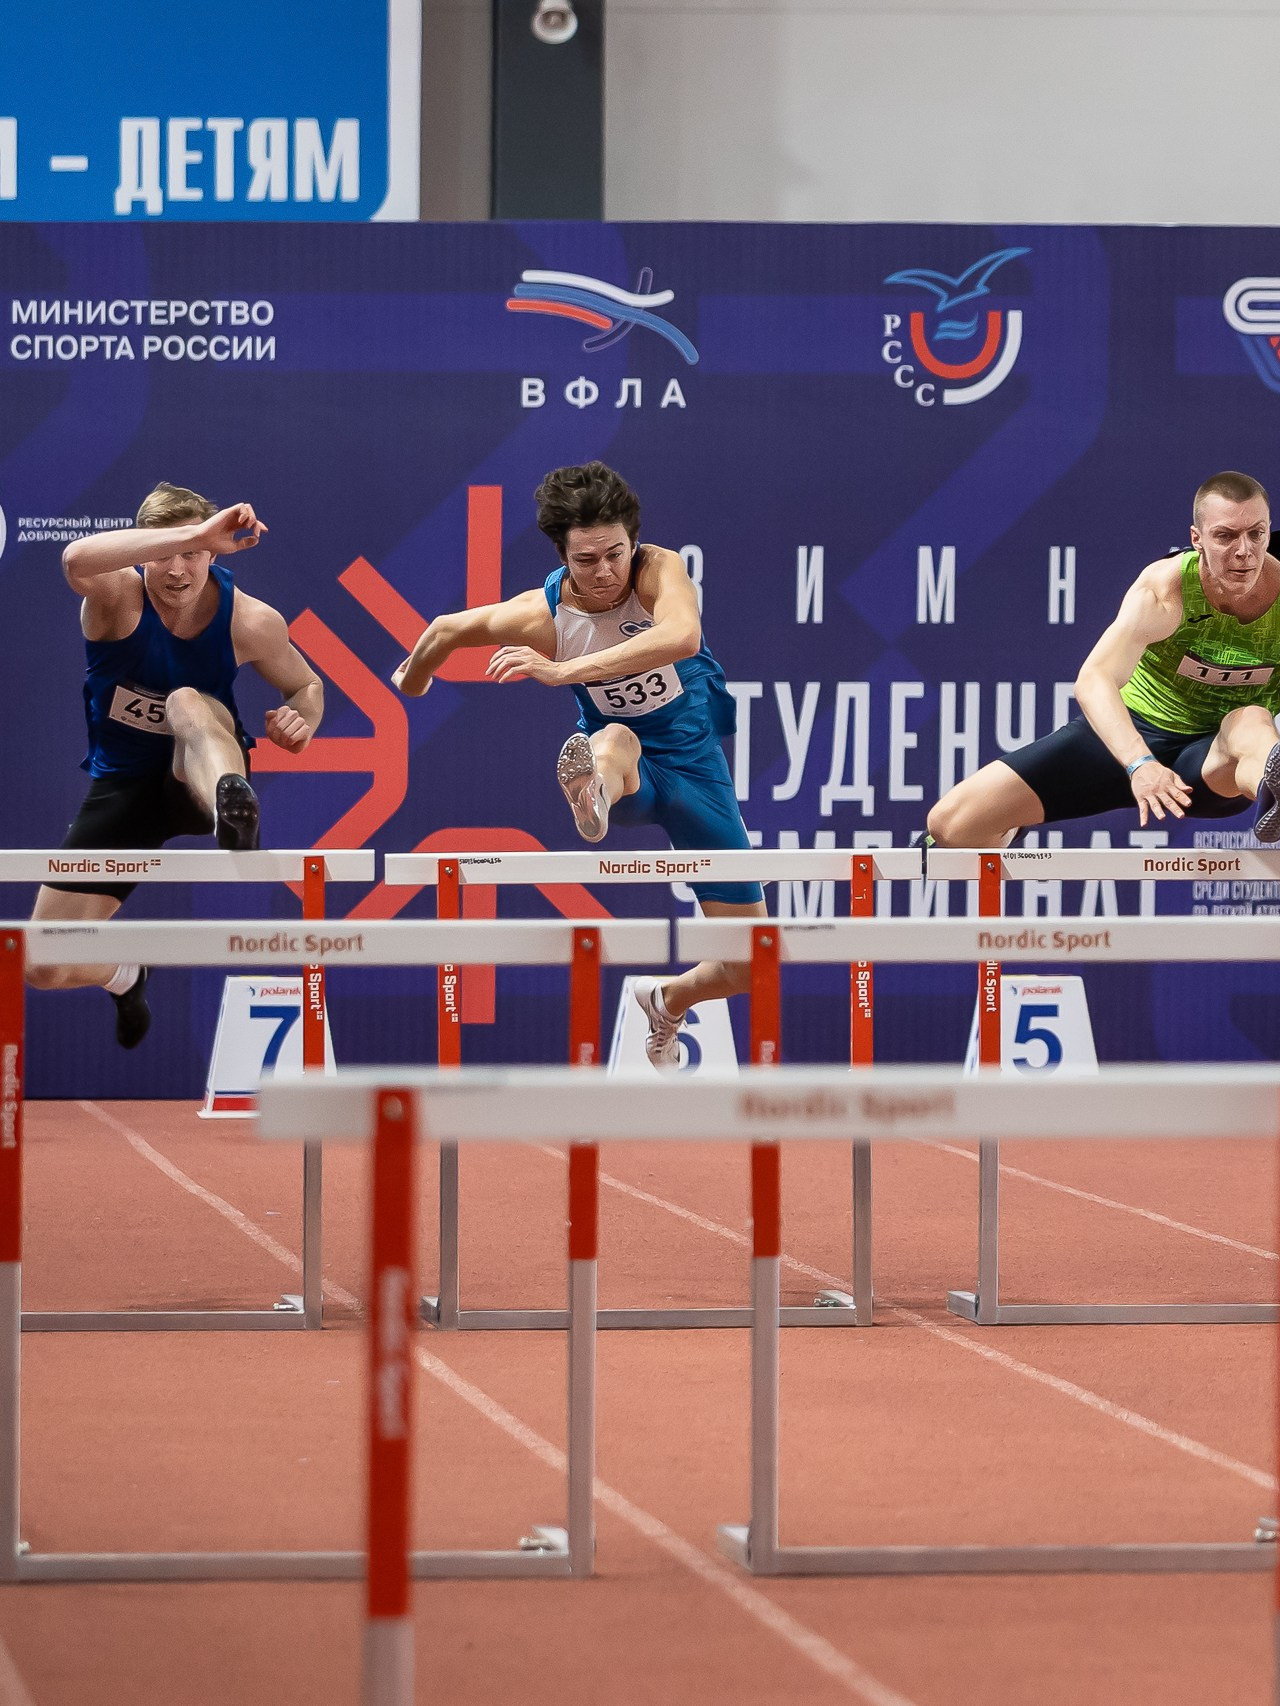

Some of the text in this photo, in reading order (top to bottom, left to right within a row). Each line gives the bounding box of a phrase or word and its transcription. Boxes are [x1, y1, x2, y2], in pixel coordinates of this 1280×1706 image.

[114, 117, 360, 215] ДЕТЯМ
[11, 300, 275, 326] МИНИСТЕРСТВО
[10, 335, 277, 361] СПОРТА РОССИИ
[18, 515, 133, 529] РЕСУРСНЫЙ ЦЕНТР
[1196, 666, 1254, 681] 111
[604, 673, 667, 708] 533
[48, 859, 148, 876] Nordic Sport
[599, 860, 698, 876] Nordic Sport
[1198, 858, 1240, 875] Sport
[304, 933, 364, 957] Sport
[1053, 930, 1111, 952] Sport
[308, 973, 322, 1014] Sport
[443, 975, 457, 1012] Sport
[855, 971, 870, 1008] Sport
[984, 978, 997, 1012] Sport
[250, 1006, 300, 1078] 7
[1013, 1004, 1063, 1075] 5
